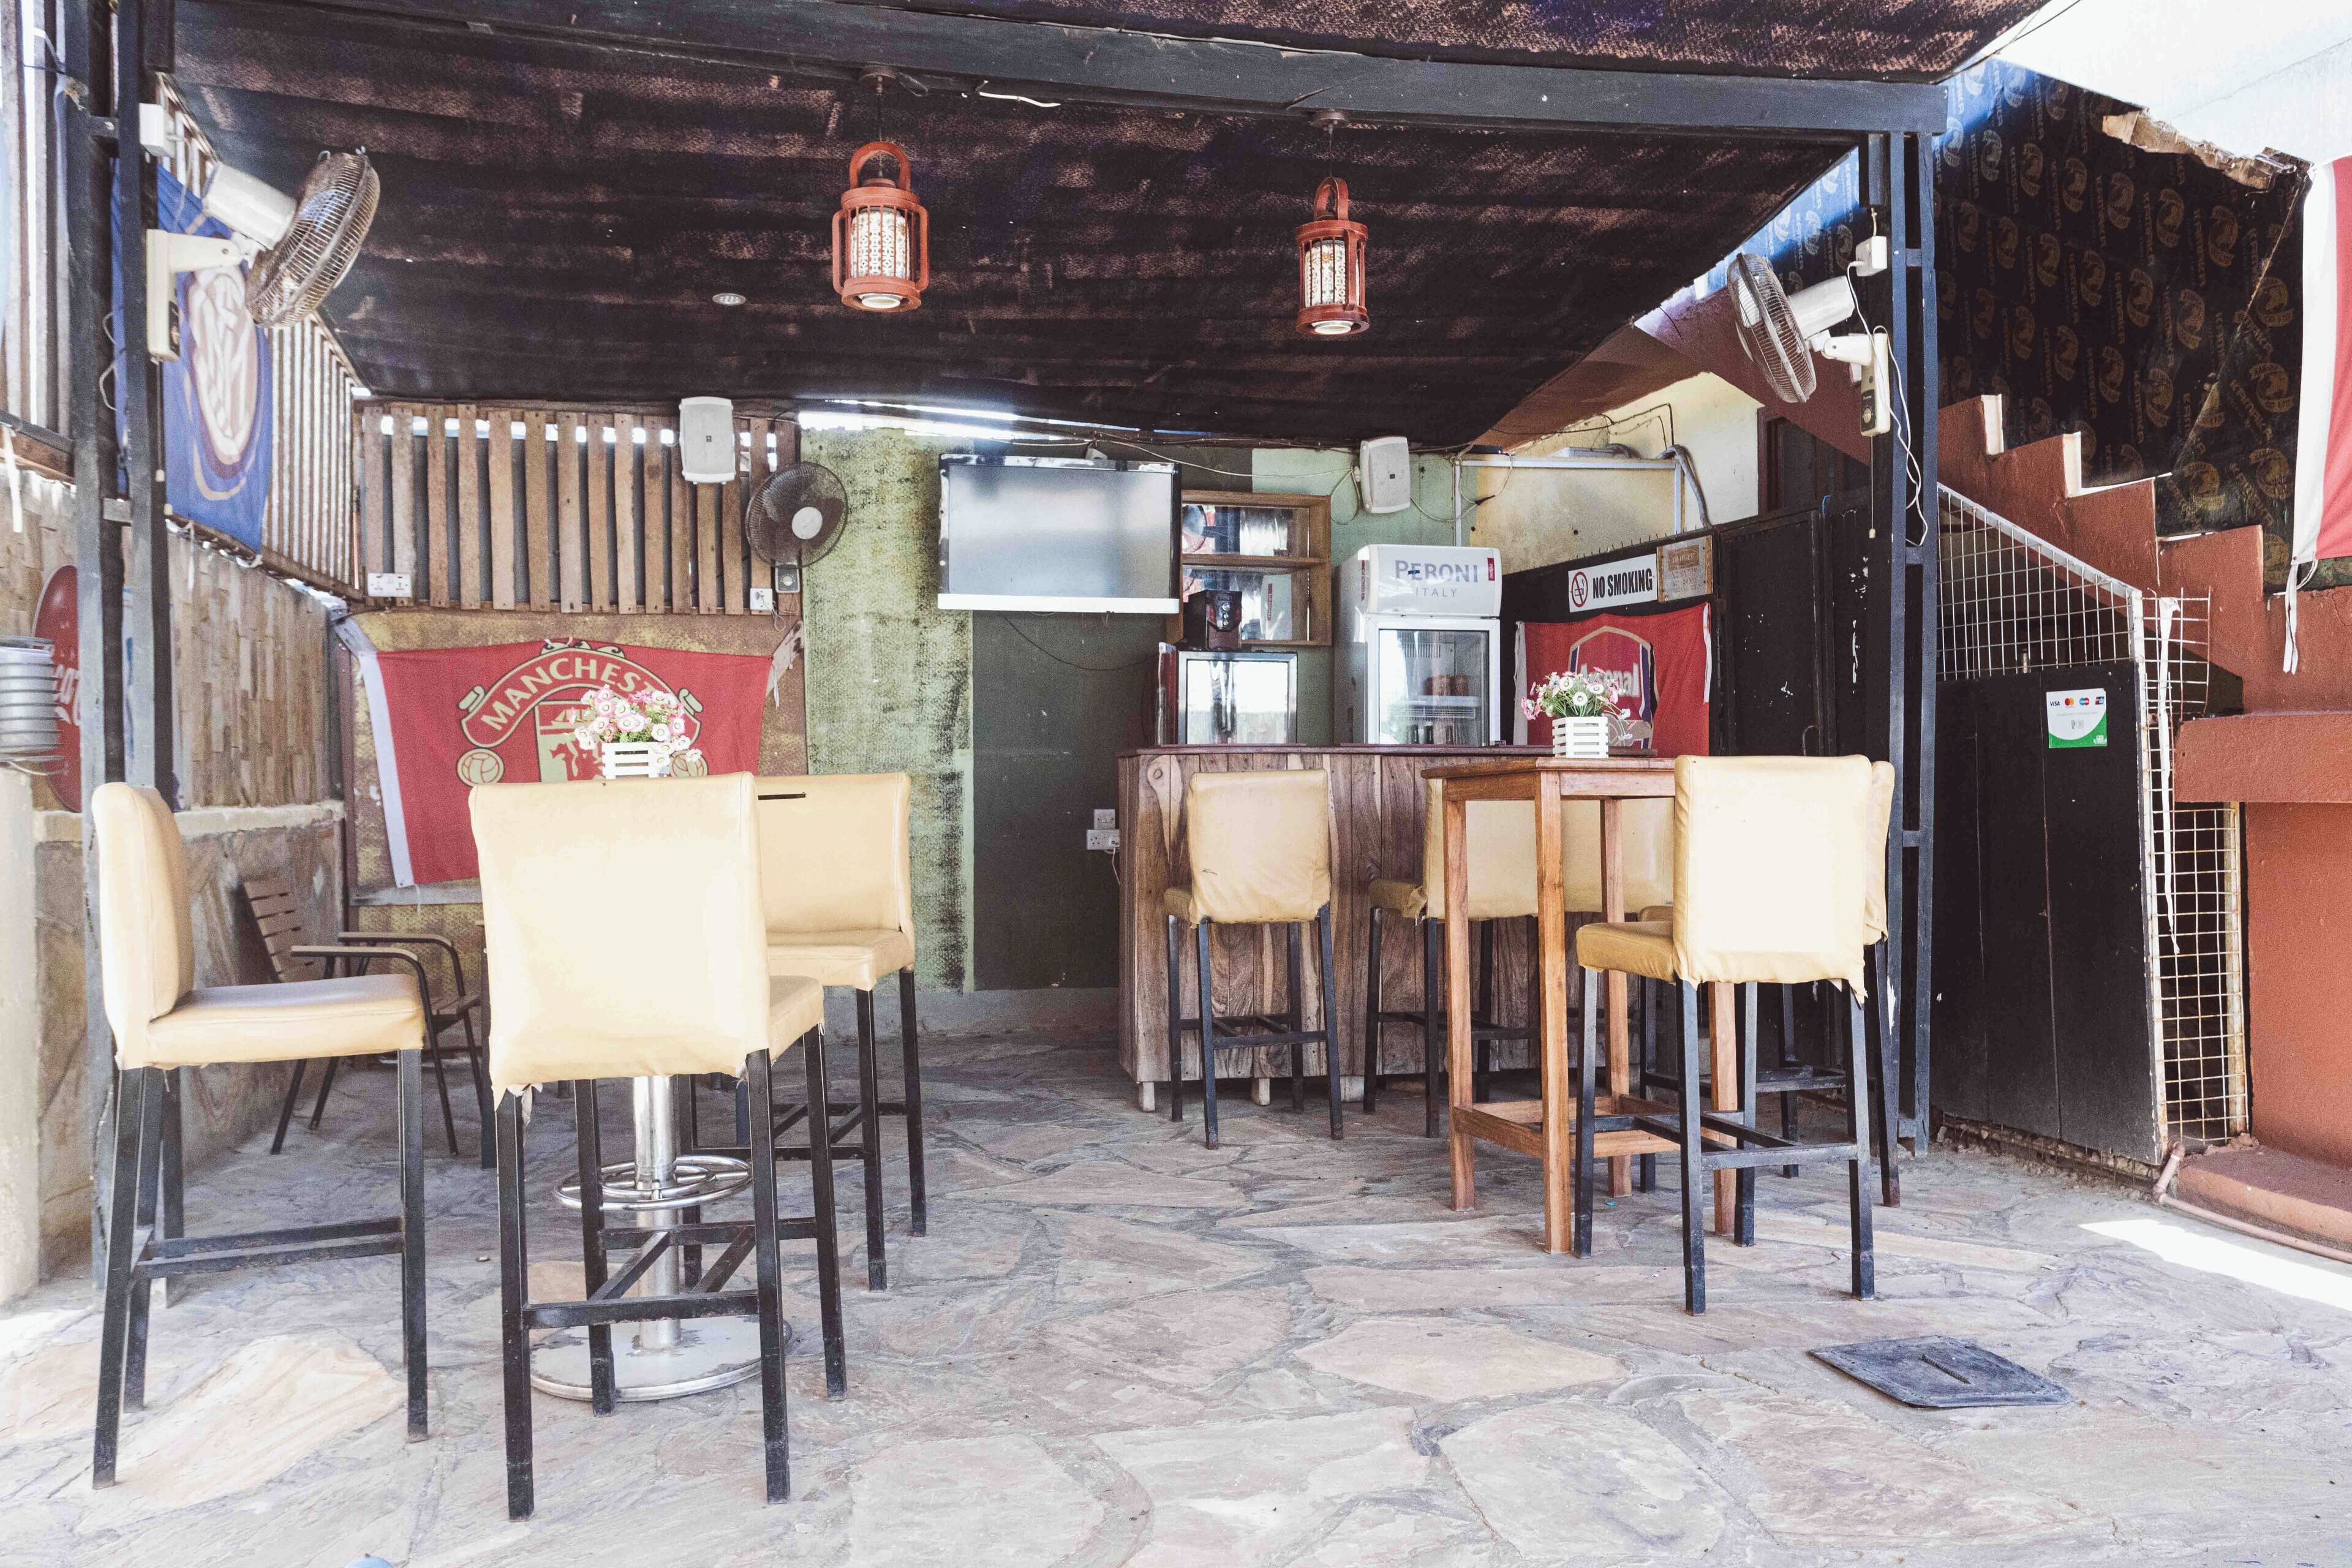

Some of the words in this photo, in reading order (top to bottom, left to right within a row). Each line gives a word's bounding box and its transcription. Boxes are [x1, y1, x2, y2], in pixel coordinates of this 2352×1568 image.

[1395, 560, 1478, 582] PERONI
[1593, 576, 1605, 599] NO
[1607, 568, 1653, 597] SMOKING
[1415, 587, 1458, 598] ITALY
[481, 657, 656, 731] MANCHEST
